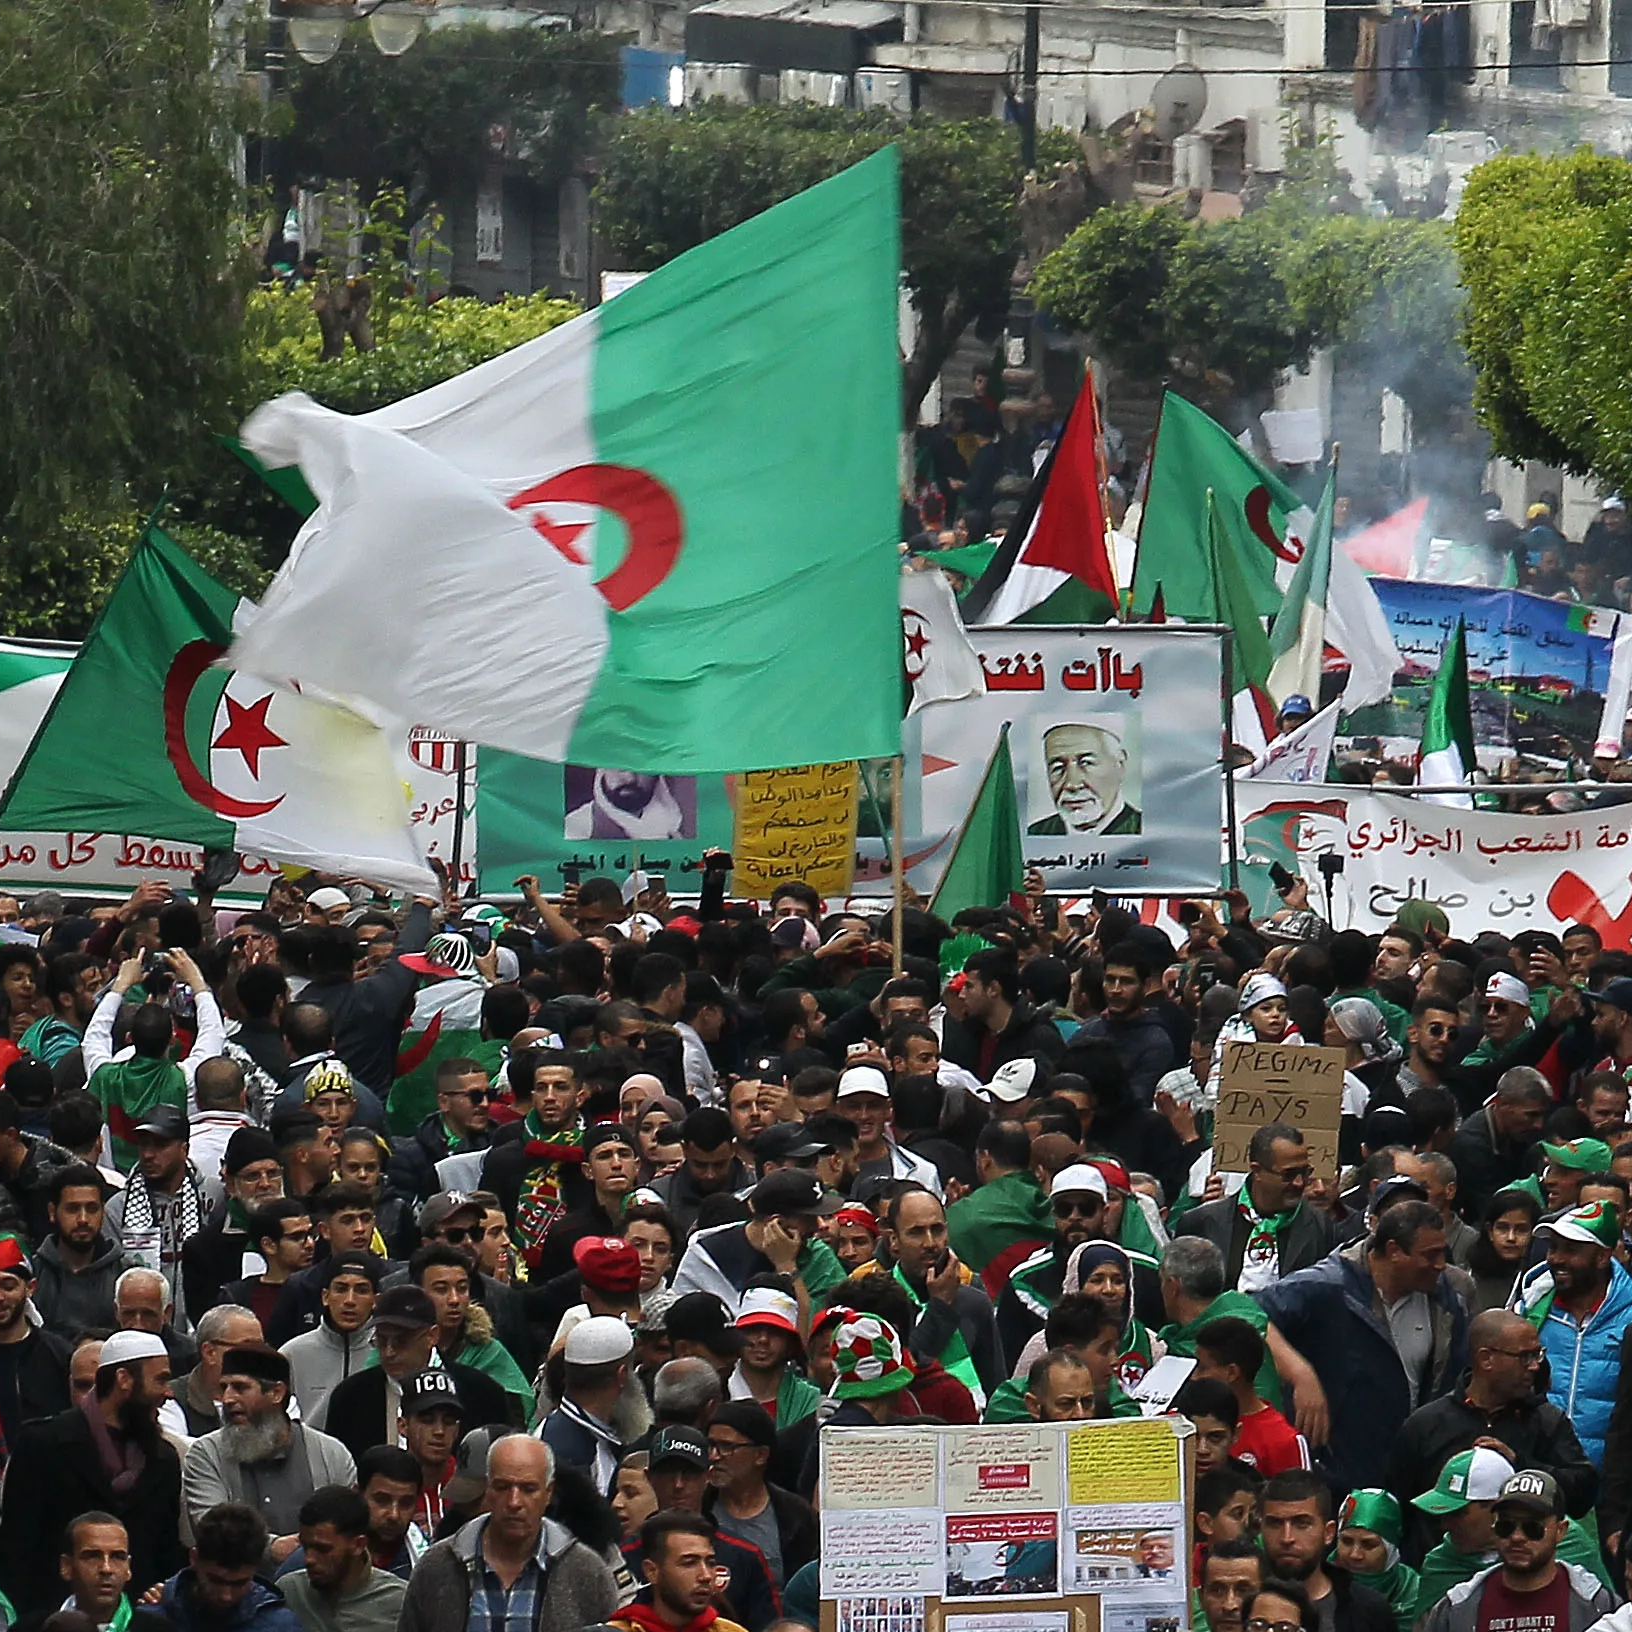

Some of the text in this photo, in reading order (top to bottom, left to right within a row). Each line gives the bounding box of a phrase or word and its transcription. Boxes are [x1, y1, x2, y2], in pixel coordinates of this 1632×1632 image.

[48, 831, 103, 872] كل
[1345, 819, 1463, 861] الجزائري
[1477, 829, 1582, 865] الشعب
[1367, 875, 1536, 920] بن صالح
[1229, 1042, 1339, 1075] REGIME
[1222, 1090, 1310, 1123] PAYS
